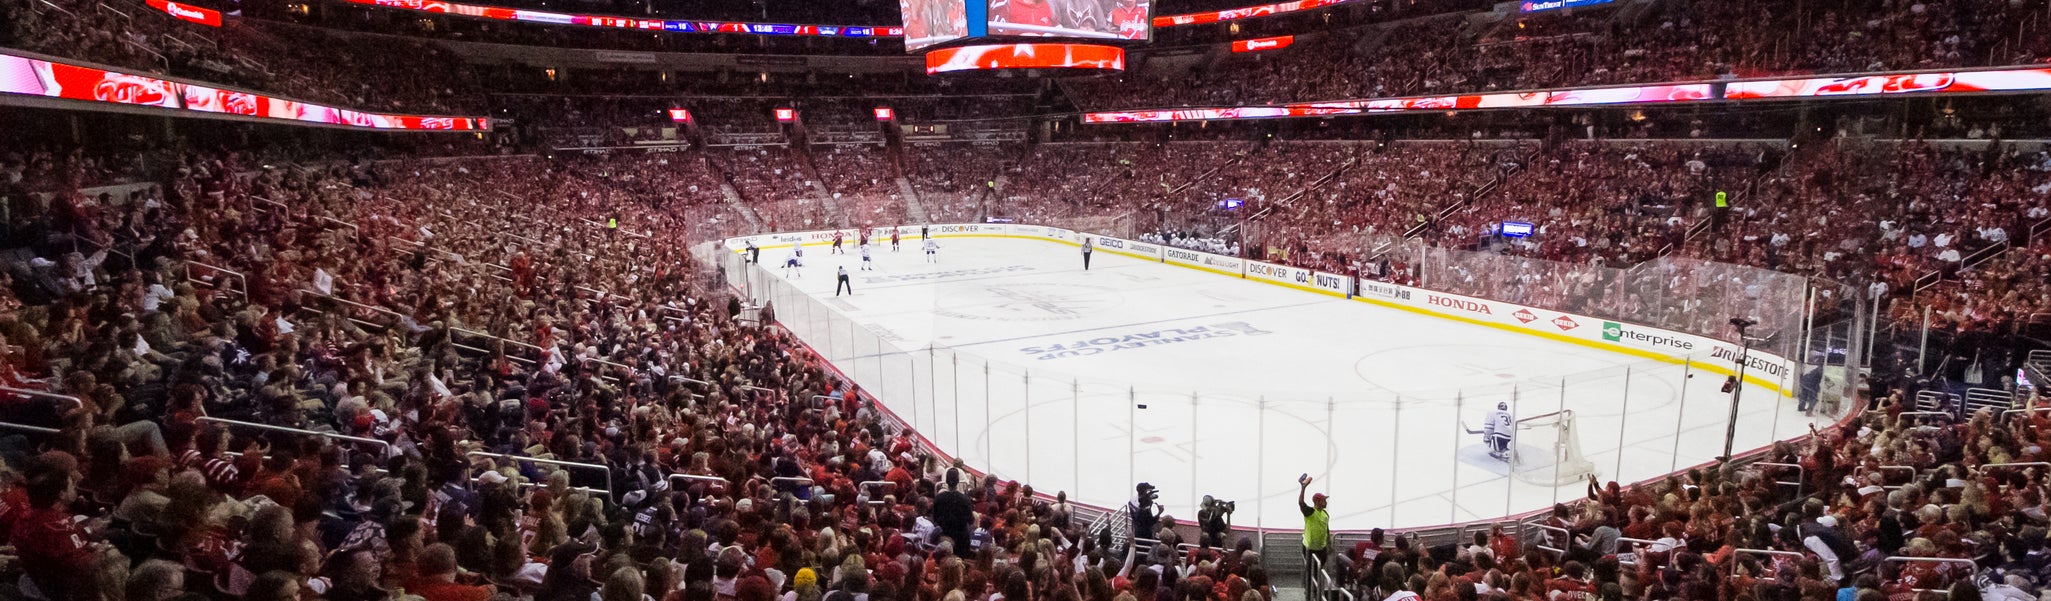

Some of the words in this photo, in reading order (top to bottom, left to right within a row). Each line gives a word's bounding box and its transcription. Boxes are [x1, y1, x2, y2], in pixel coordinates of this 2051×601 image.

[1099, 236, 1123, 249] GEICO
[1167, 249, 1200, 262] GATORADE
[1249, 263, 1287, 279] DISCOVER
[1316, 274, 1340, 290] NUTS!
[1427, 294, 1493, 315] HONDA
[1514, 311, 1535, 321] ORKIN
[1554, 318, 1576, 329] ORKIN
[1019, 324, 1212, 355] PLAYOFFS
[1111, 329, 1239, 352] STANLEY
[1604, 326, 1694, 350] enterprise
[1036, 346, 1106, 361] CUP
